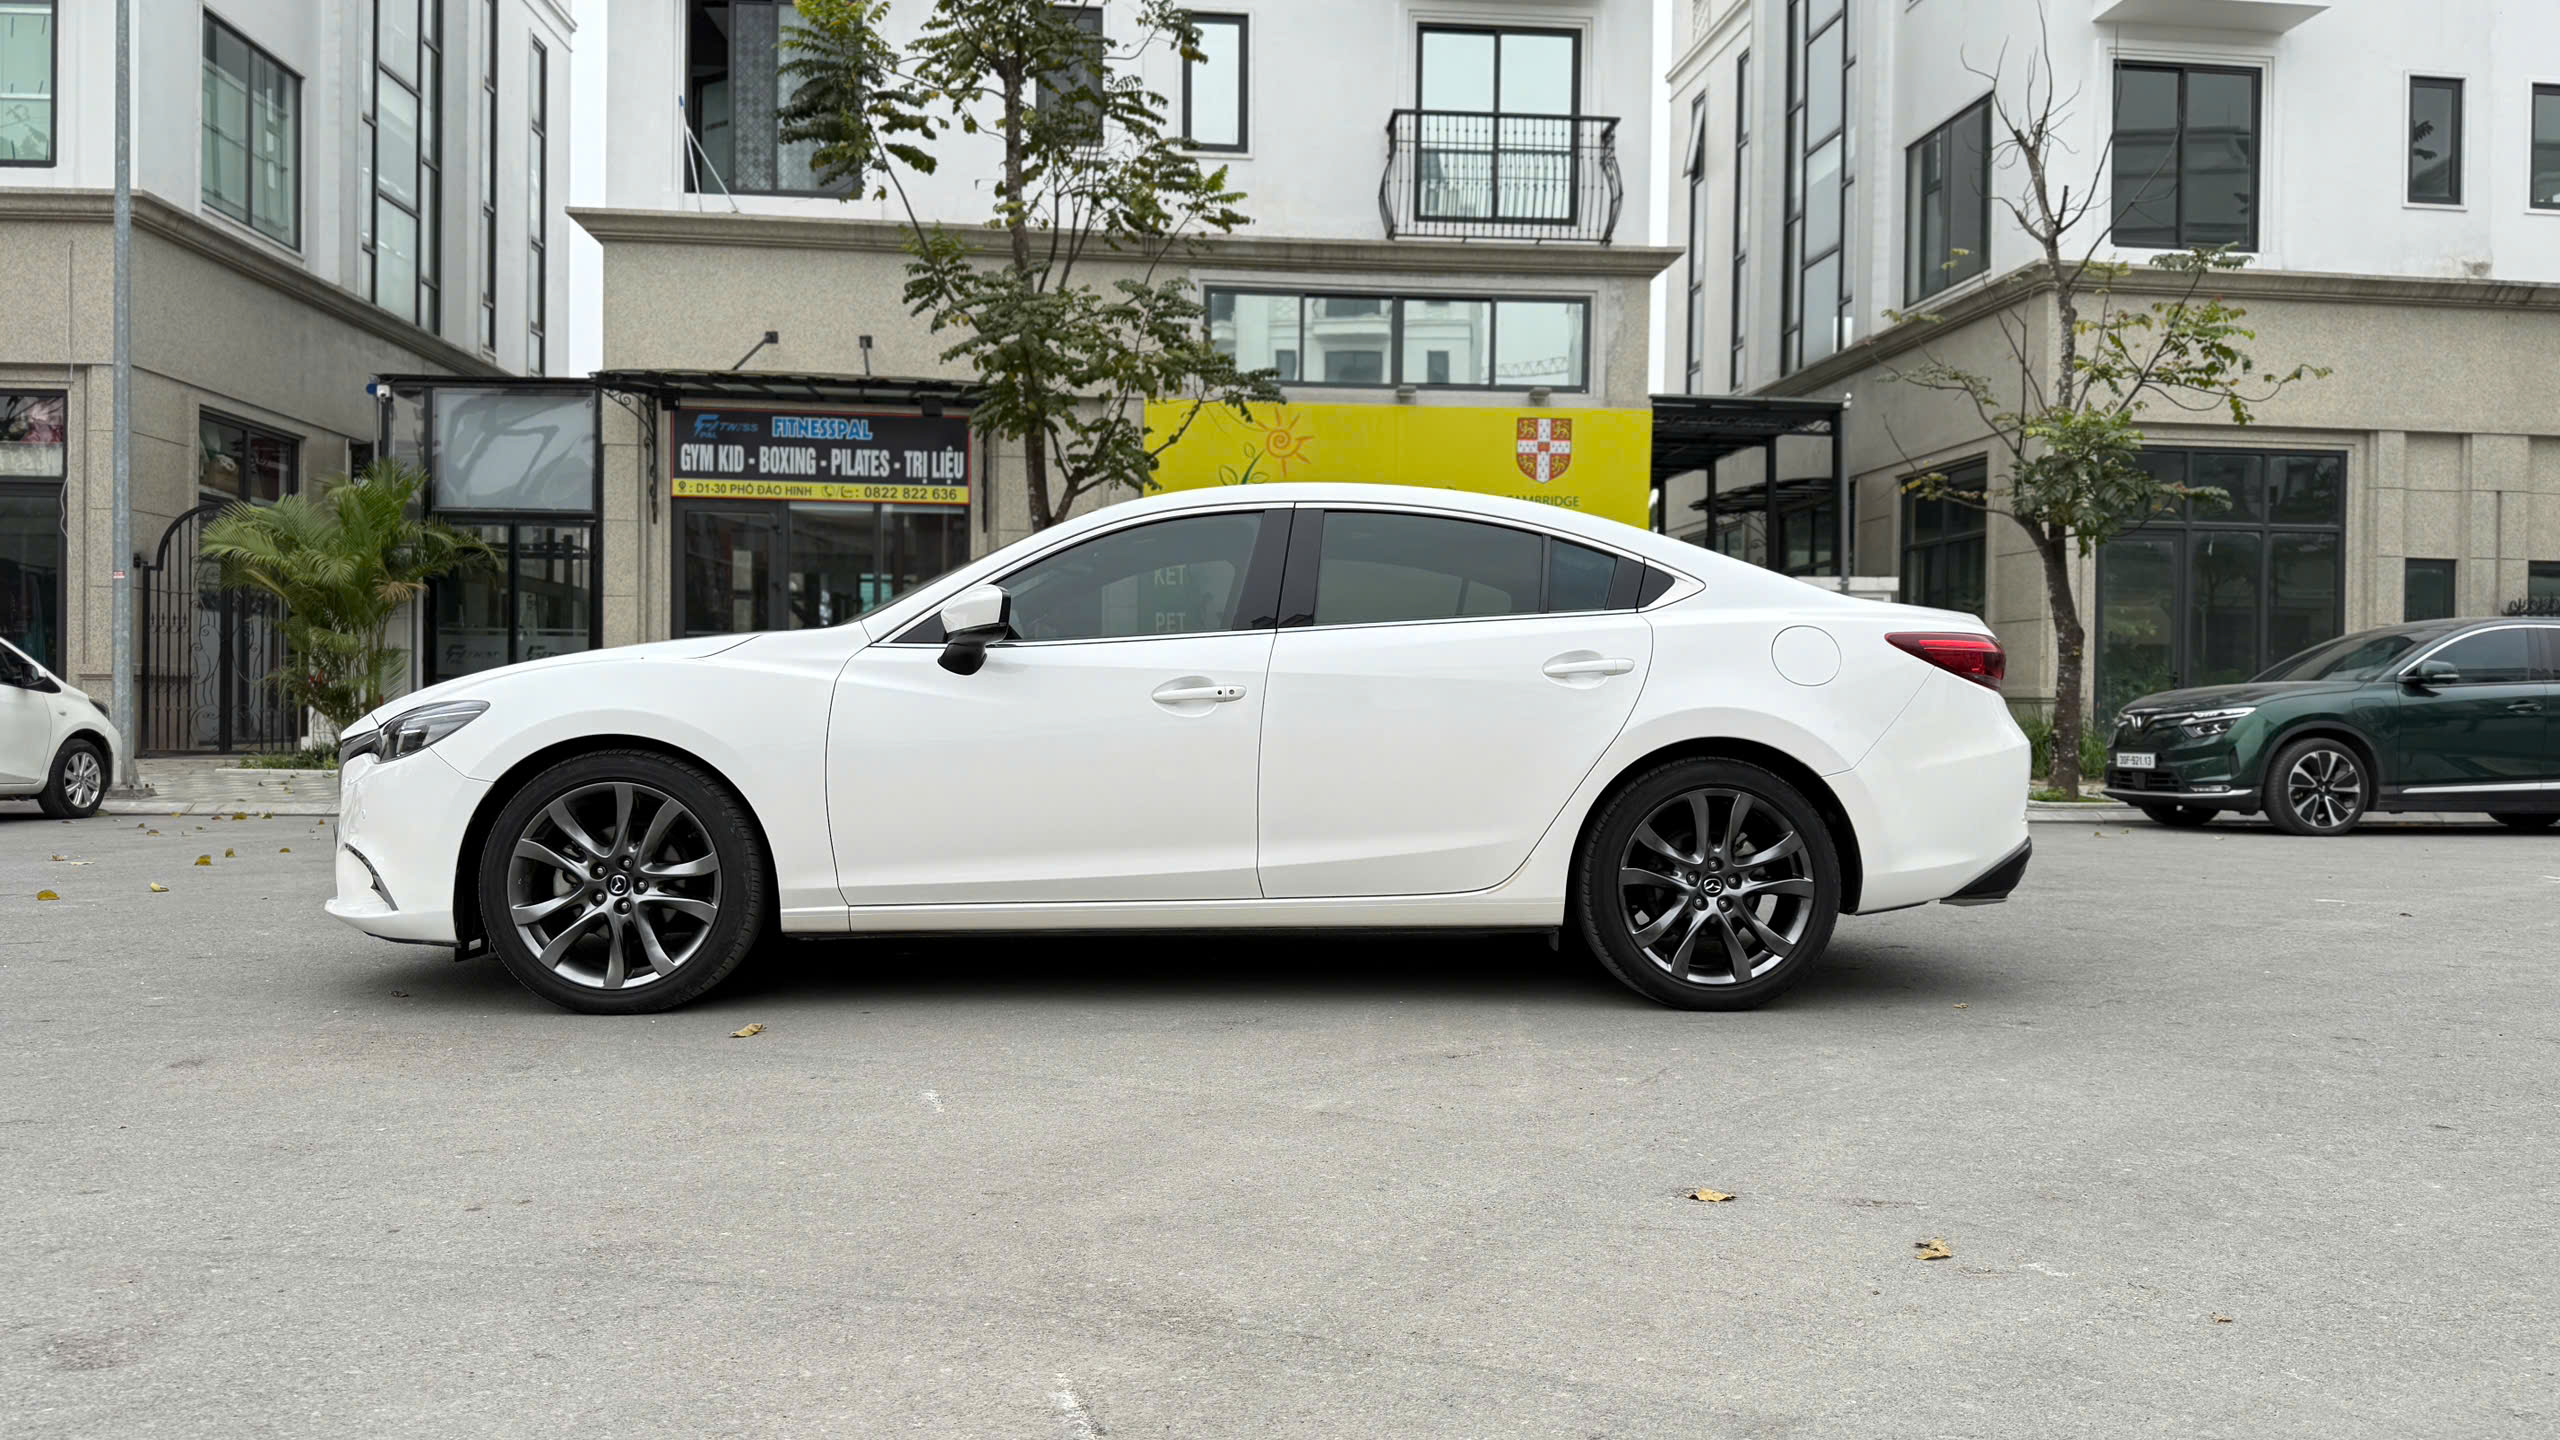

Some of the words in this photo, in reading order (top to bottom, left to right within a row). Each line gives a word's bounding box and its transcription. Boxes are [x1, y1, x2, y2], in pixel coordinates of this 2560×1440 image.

[771, 416, 873, 440] FITNESSPAL
[680, 443, 714, 472] GYM
[718, 445, 745, 473] KID
[759, 445, 817, 475] BOXING
[830, 448, 891, 477] PILATES
[904, 450, 928, 484] TRỊ
[931, 445, 965, 485] LIỆU
[696, 483, 727, 494] D1-30
[785, 486, 812, 497] HINH
[864, 486, 898, 499] 0822
[902, 487, 928, 500] 822
[932, 488, 957, 501] 636
[1154, 564, 1186, 585] KET
[1155, 612, 1186, 633] PET
